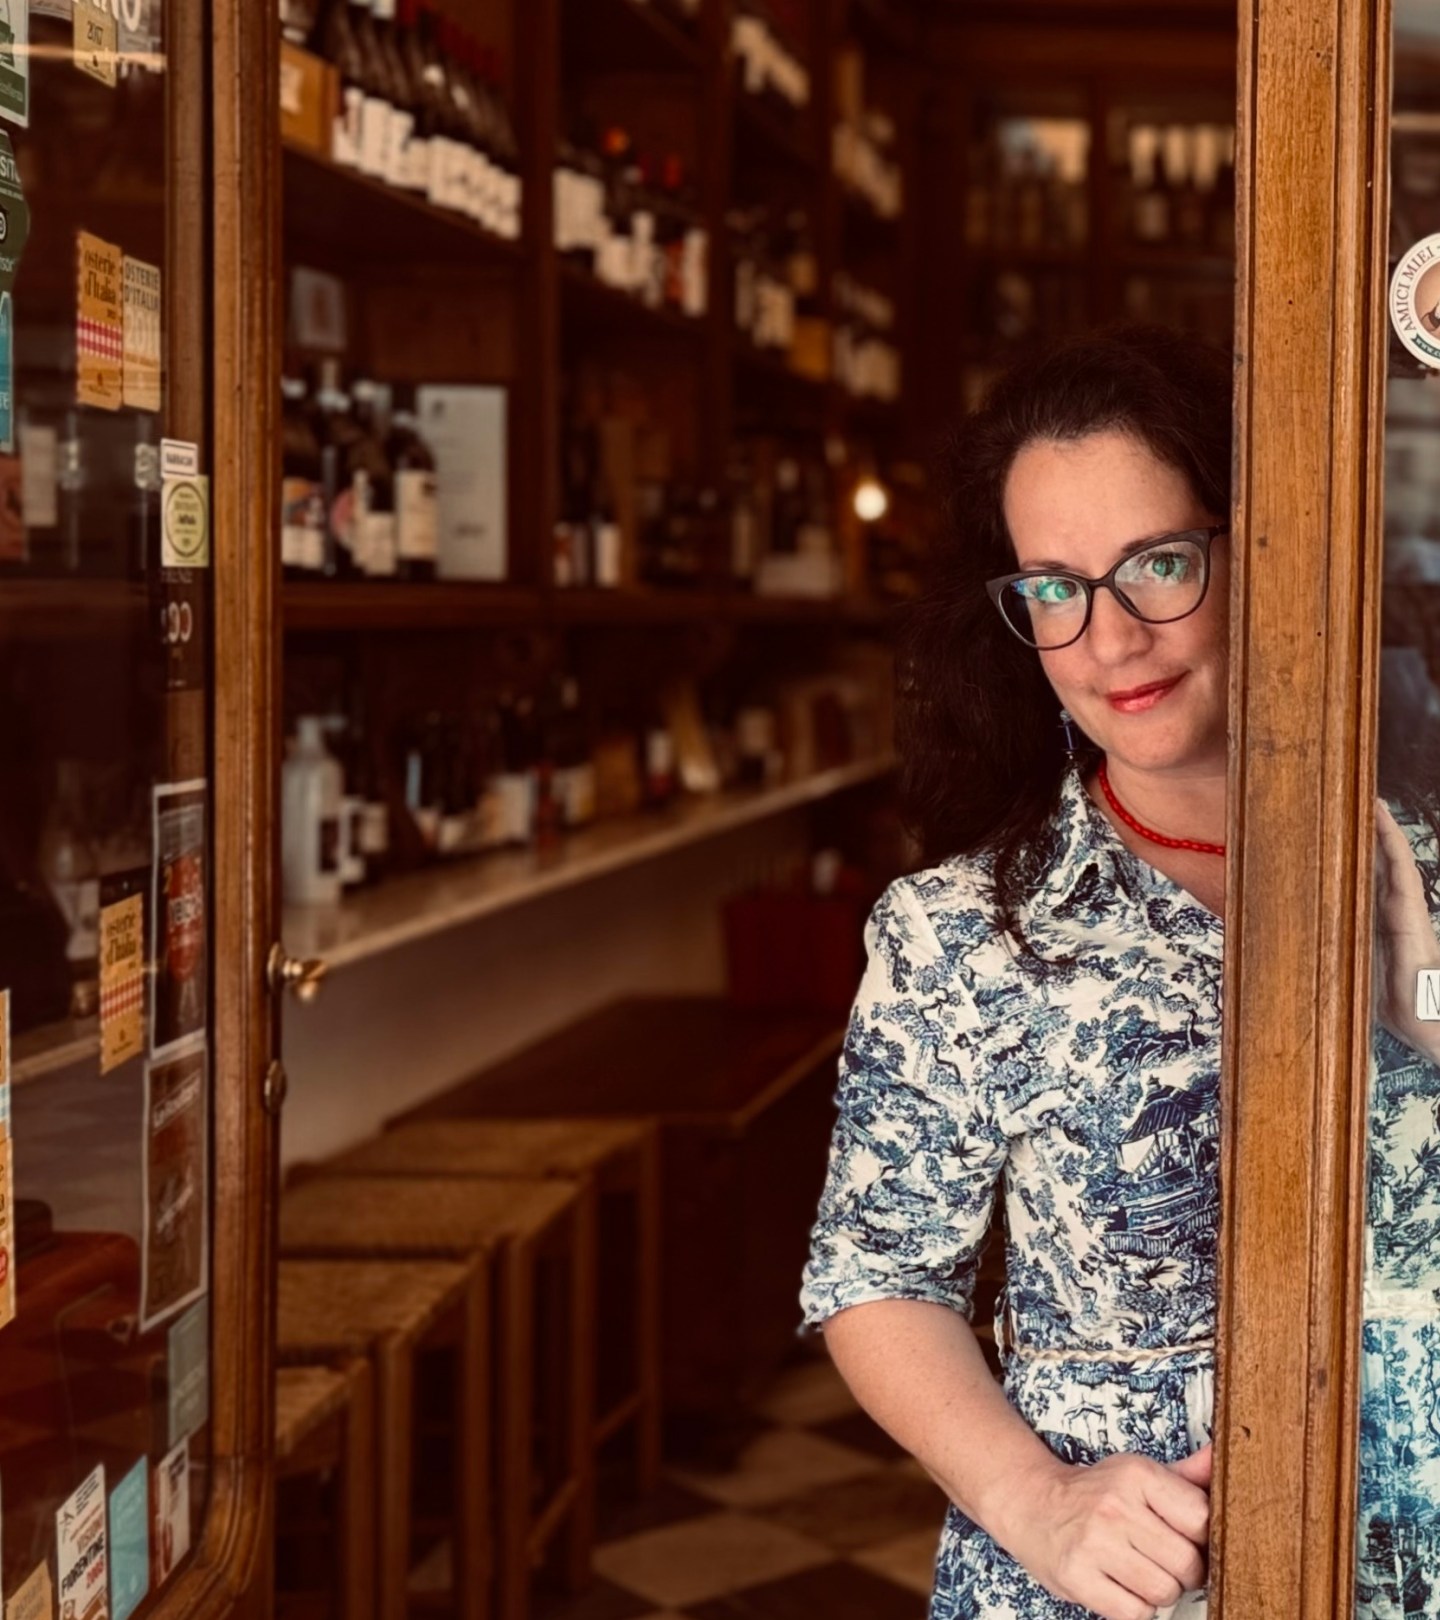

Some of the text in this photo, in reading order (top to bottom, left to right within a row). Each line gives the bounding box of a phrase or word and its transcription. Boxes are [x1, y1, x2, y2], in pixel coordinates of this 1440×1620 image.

[125, 260, 160, 291] OSTERIE
[1402, 245, 1435, 280] MIEI
[1396, 282, 1417, 332] AMICI
